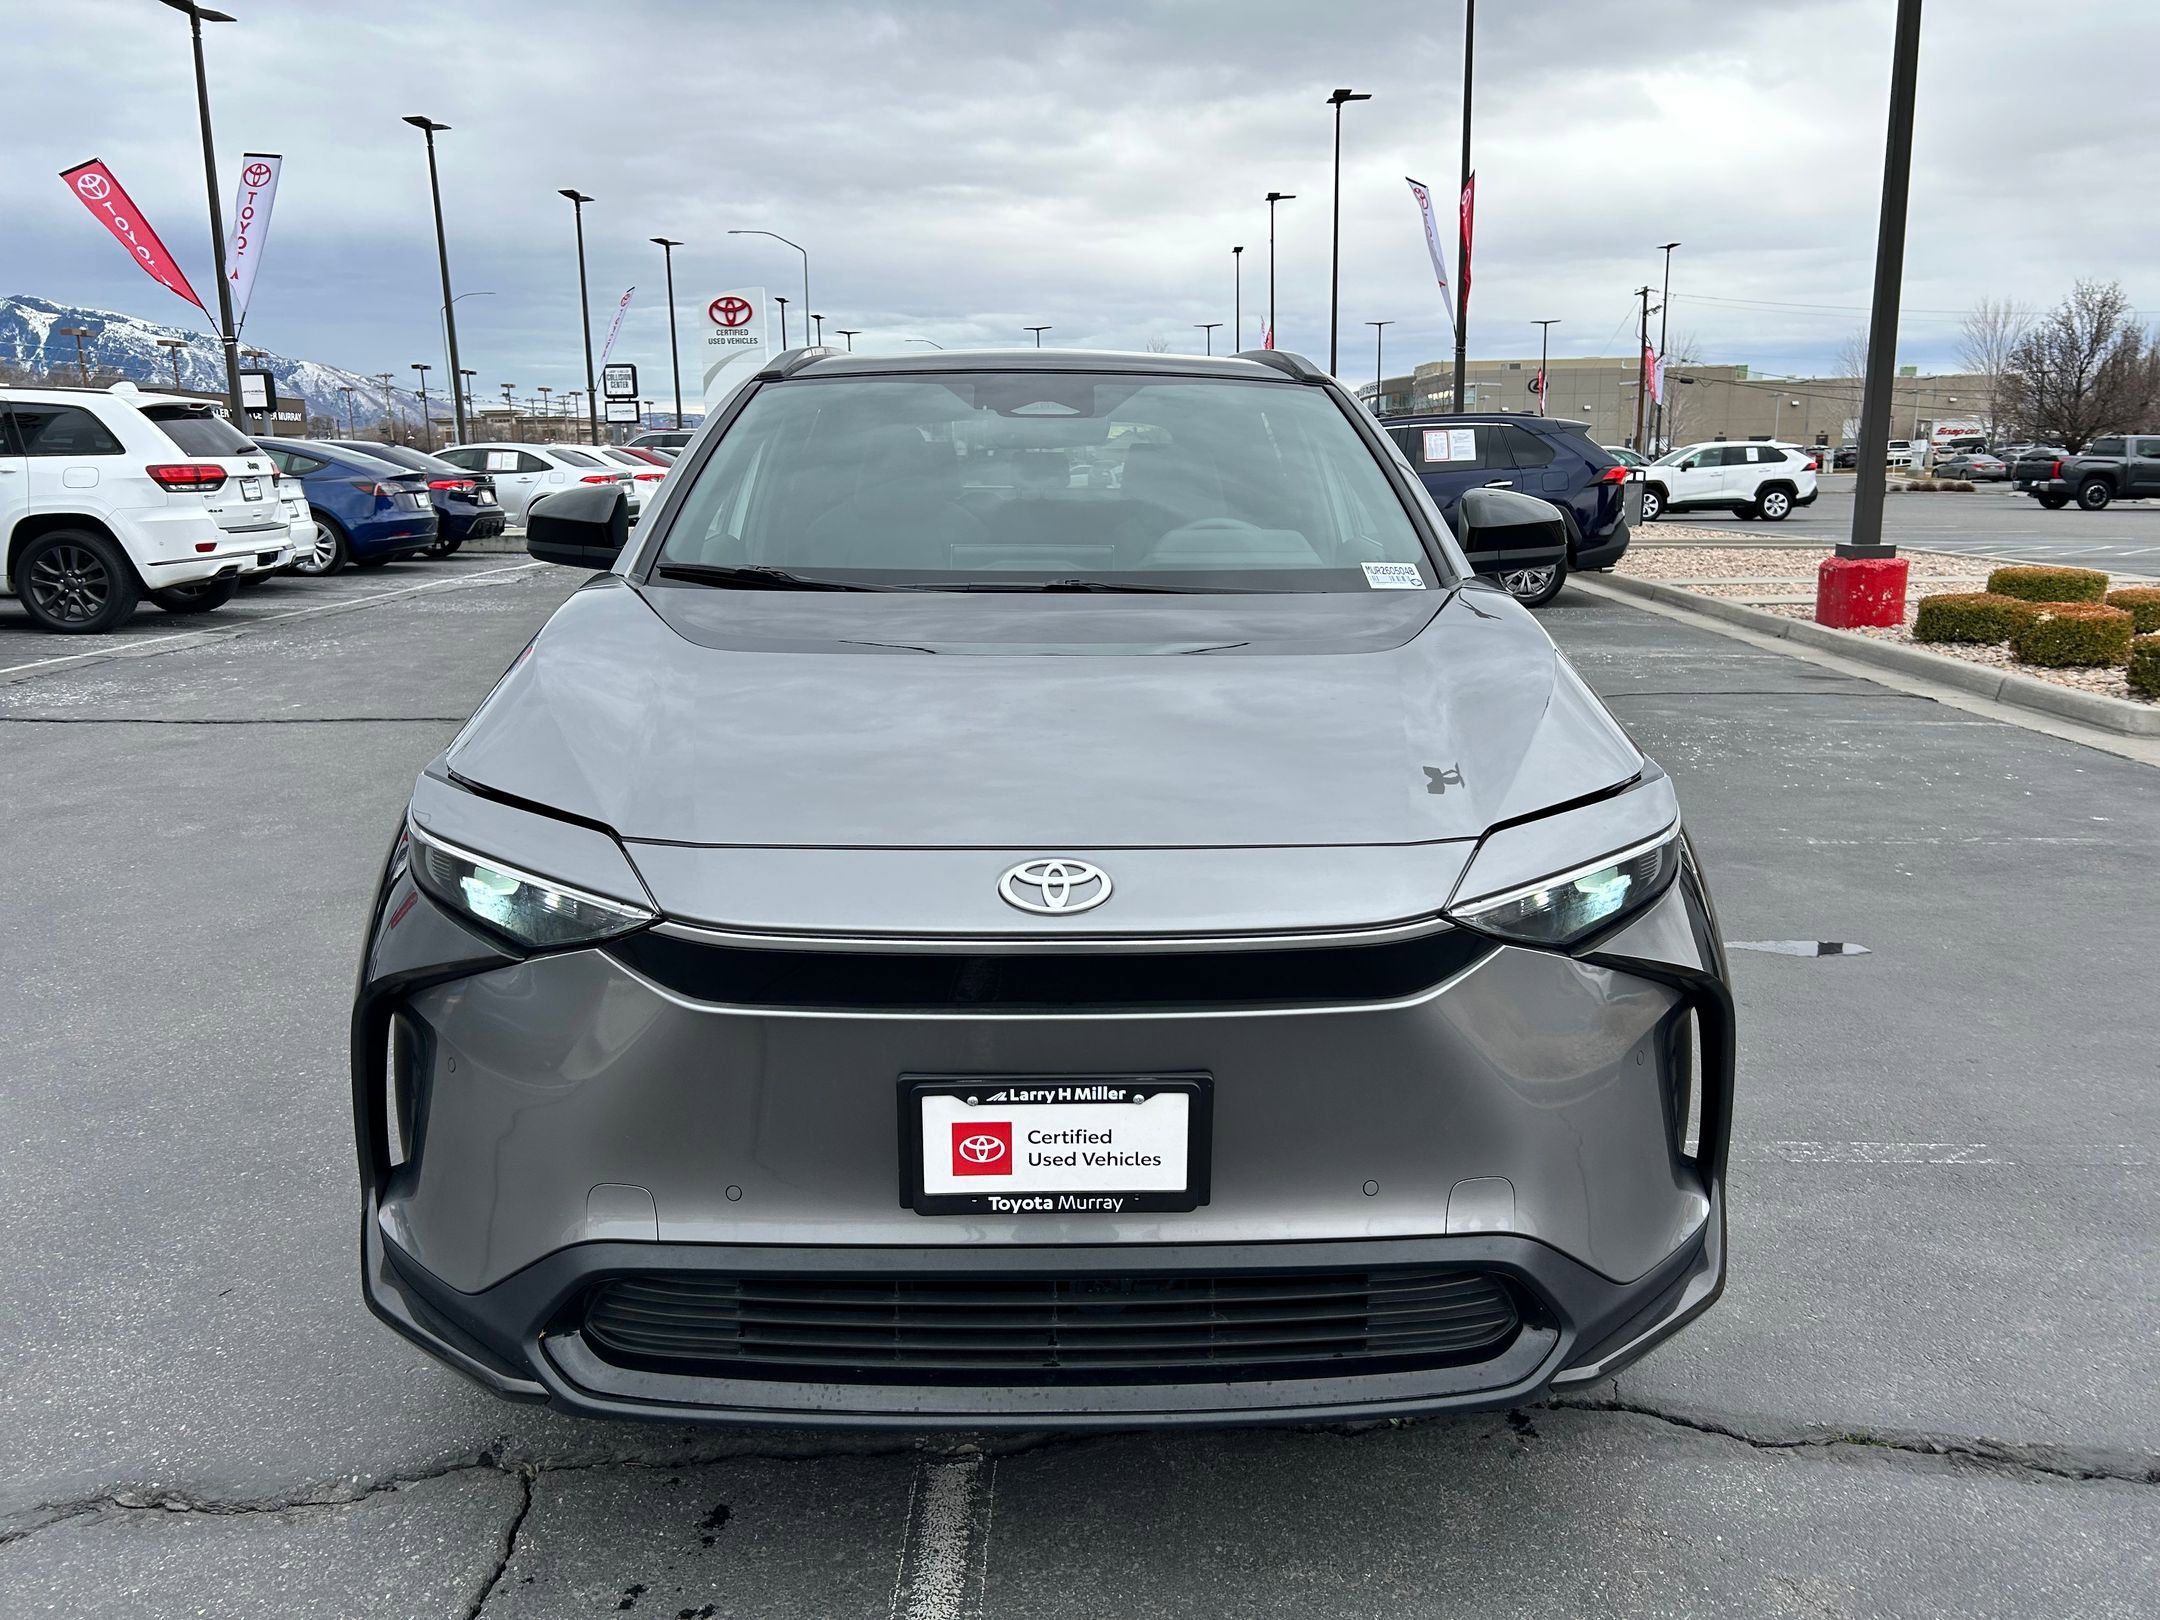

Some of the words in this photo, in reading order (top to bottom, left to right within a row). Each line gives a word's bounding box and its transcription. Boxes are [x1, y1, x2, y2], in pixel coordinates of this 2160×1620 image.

[708, 337, 726, 345] USED
[727, 337, 758, 345] VEHICLES
[610, 381, 629, 389] CENTER
[278, 412, 302, 421] MURRAY
[1010, 1088, 1056, 1103] Larry
[1058, 1087, 1072, 1101] H
[1074, 1085, 1126, 1101] Miller
[1027, 1129, 1112, 1144] Certified
[1028, 1151, 1077, 1166] Used
[1081, 1151, 1162, 1166] Vehicles
[987, 1196, 1053, 1214] Toyota
[1057, 1195, 1124, 1213] Murray
